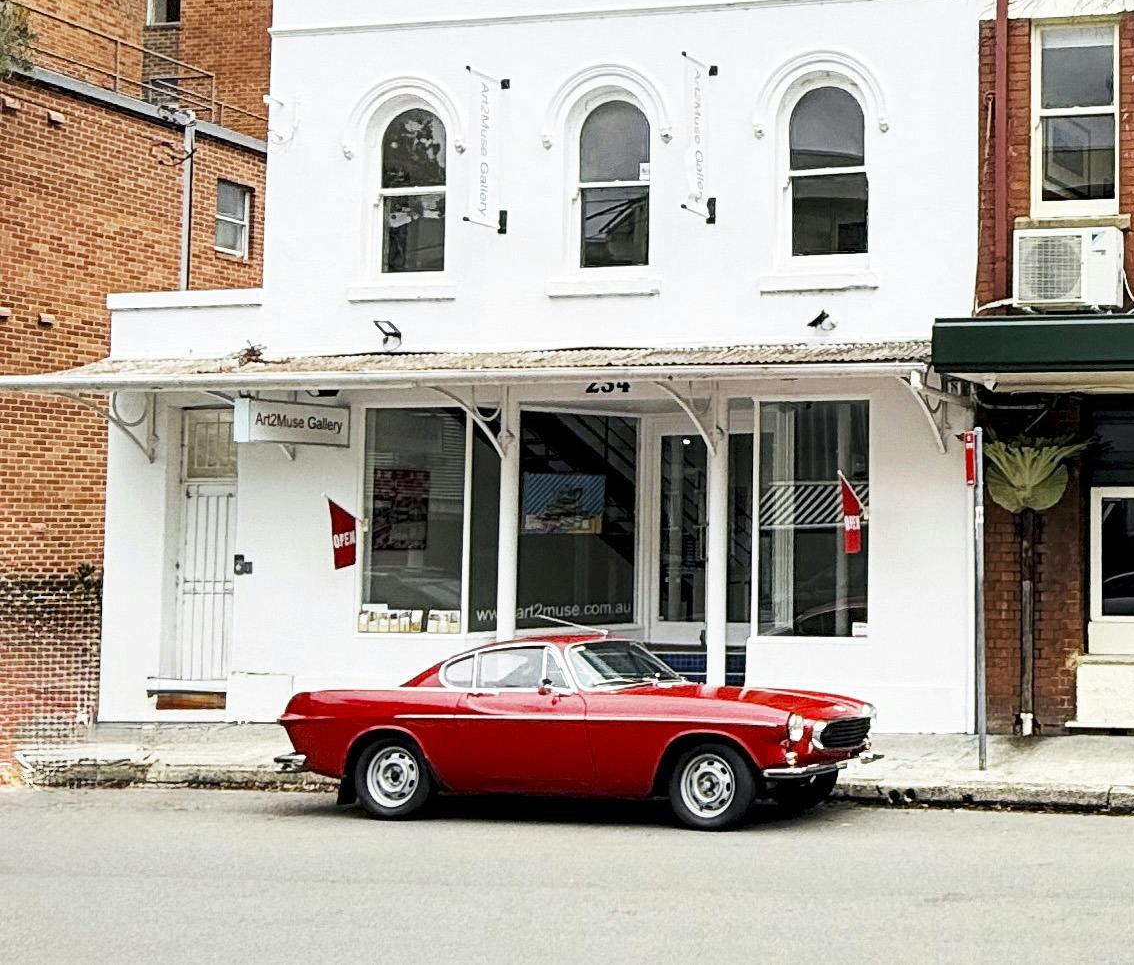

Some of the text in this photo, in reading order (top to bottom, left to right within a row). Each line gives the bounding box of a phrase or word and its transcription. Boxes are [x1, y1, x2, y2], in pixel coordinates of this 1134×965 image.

[478, 81, 490, 217] Art2Muse Gallery
[255, 412, 343, 434] Art2Muse Gallery
[333, 530, 356, 549] OPEN
